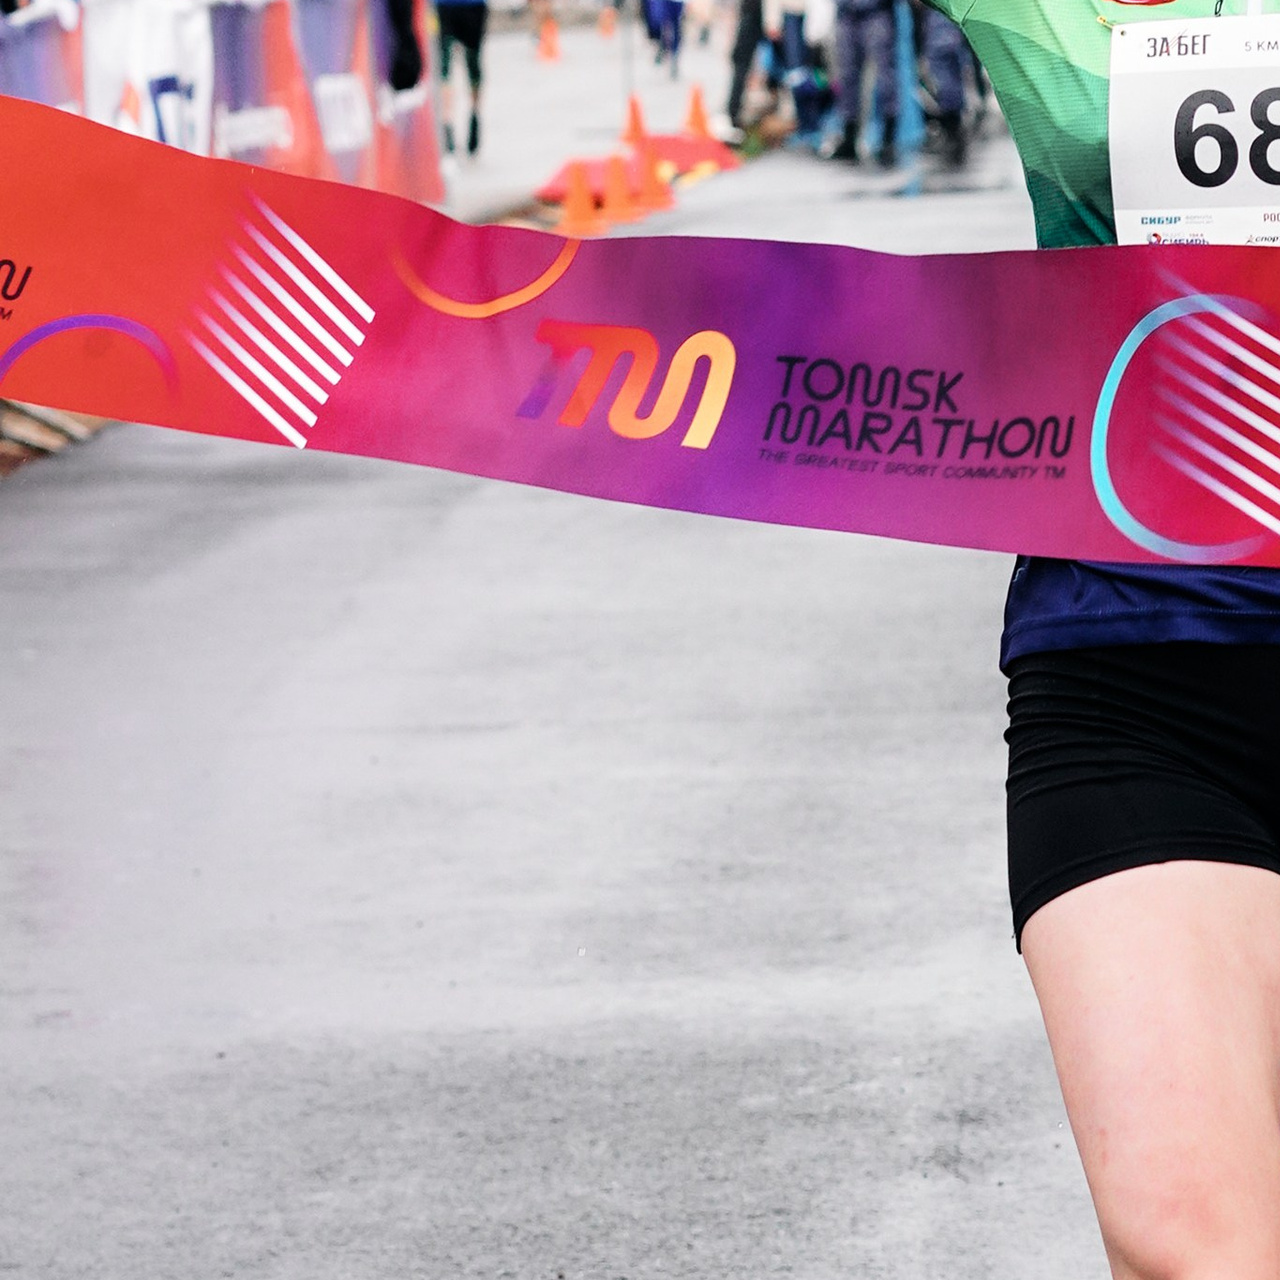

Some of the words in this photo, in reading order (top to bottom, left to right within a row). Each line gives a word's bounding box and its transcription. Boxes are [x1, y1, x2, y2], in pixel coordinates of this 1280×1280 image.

[1244, 40, 1251, 52] 5
[1141, 216, 1181, 225] СИБУР
[776, 355, 965, 414] TOMSK
[762, 401, 1076, 460] MARATHON
[758, 447, 790, 464] THE
[794, 453, 879, 474] GREATEST
[883, 461, 938, 478] SPORT
[943, 464, 1038, 481] COMMUNITY
[1043, 465, 1067, 480] TM
